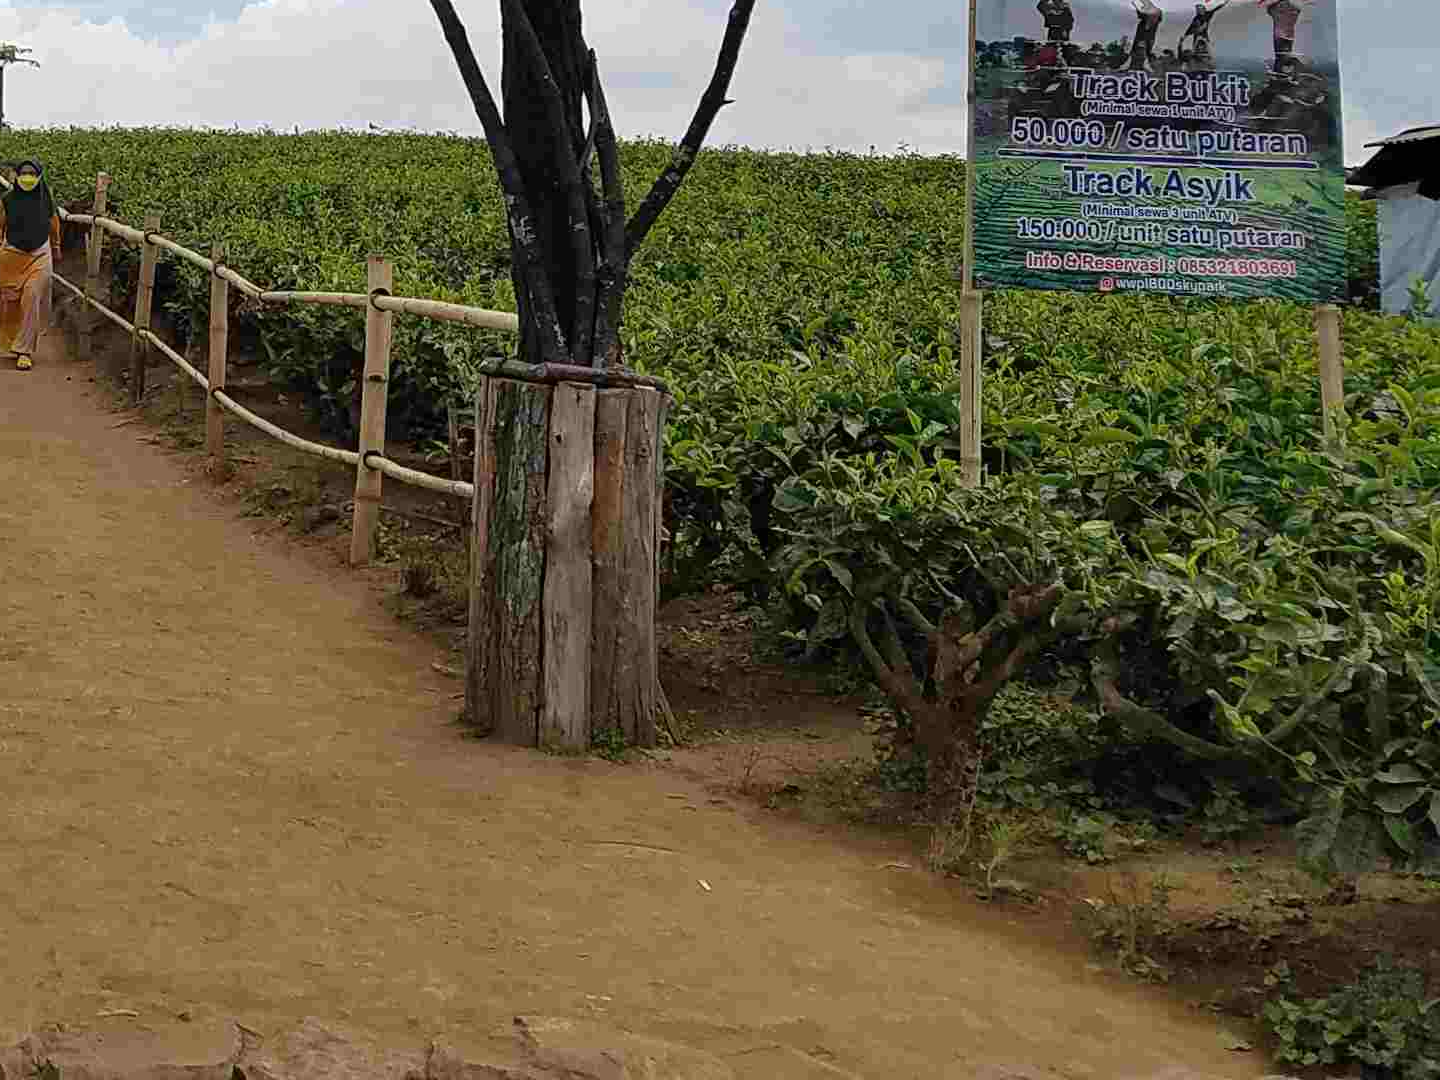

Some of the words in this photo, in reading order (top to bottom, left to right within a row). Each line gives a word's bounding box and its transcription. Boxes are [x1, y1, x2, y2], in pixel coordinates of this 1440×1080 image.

[1070, 69, 1159, 104] Track
[1166, 71, 1250, 106] Bukit
[1012, 117, 1105, 148] 50.000
[1127, 127, 1189, 152] satu
[1198, 128, 1308, 157] putaran
[1063, 164, 1154, 197] Track
[1162, 168, 1254, 207] Asyik
[1017, 216, 1103, 242] 150.000
[1118, 221, 1160, 243] unit
[1166, 225, 1211, 246] satu
[1216, 228, 1306, 250] putaran
[1026, 251, 1062, 271] Info
